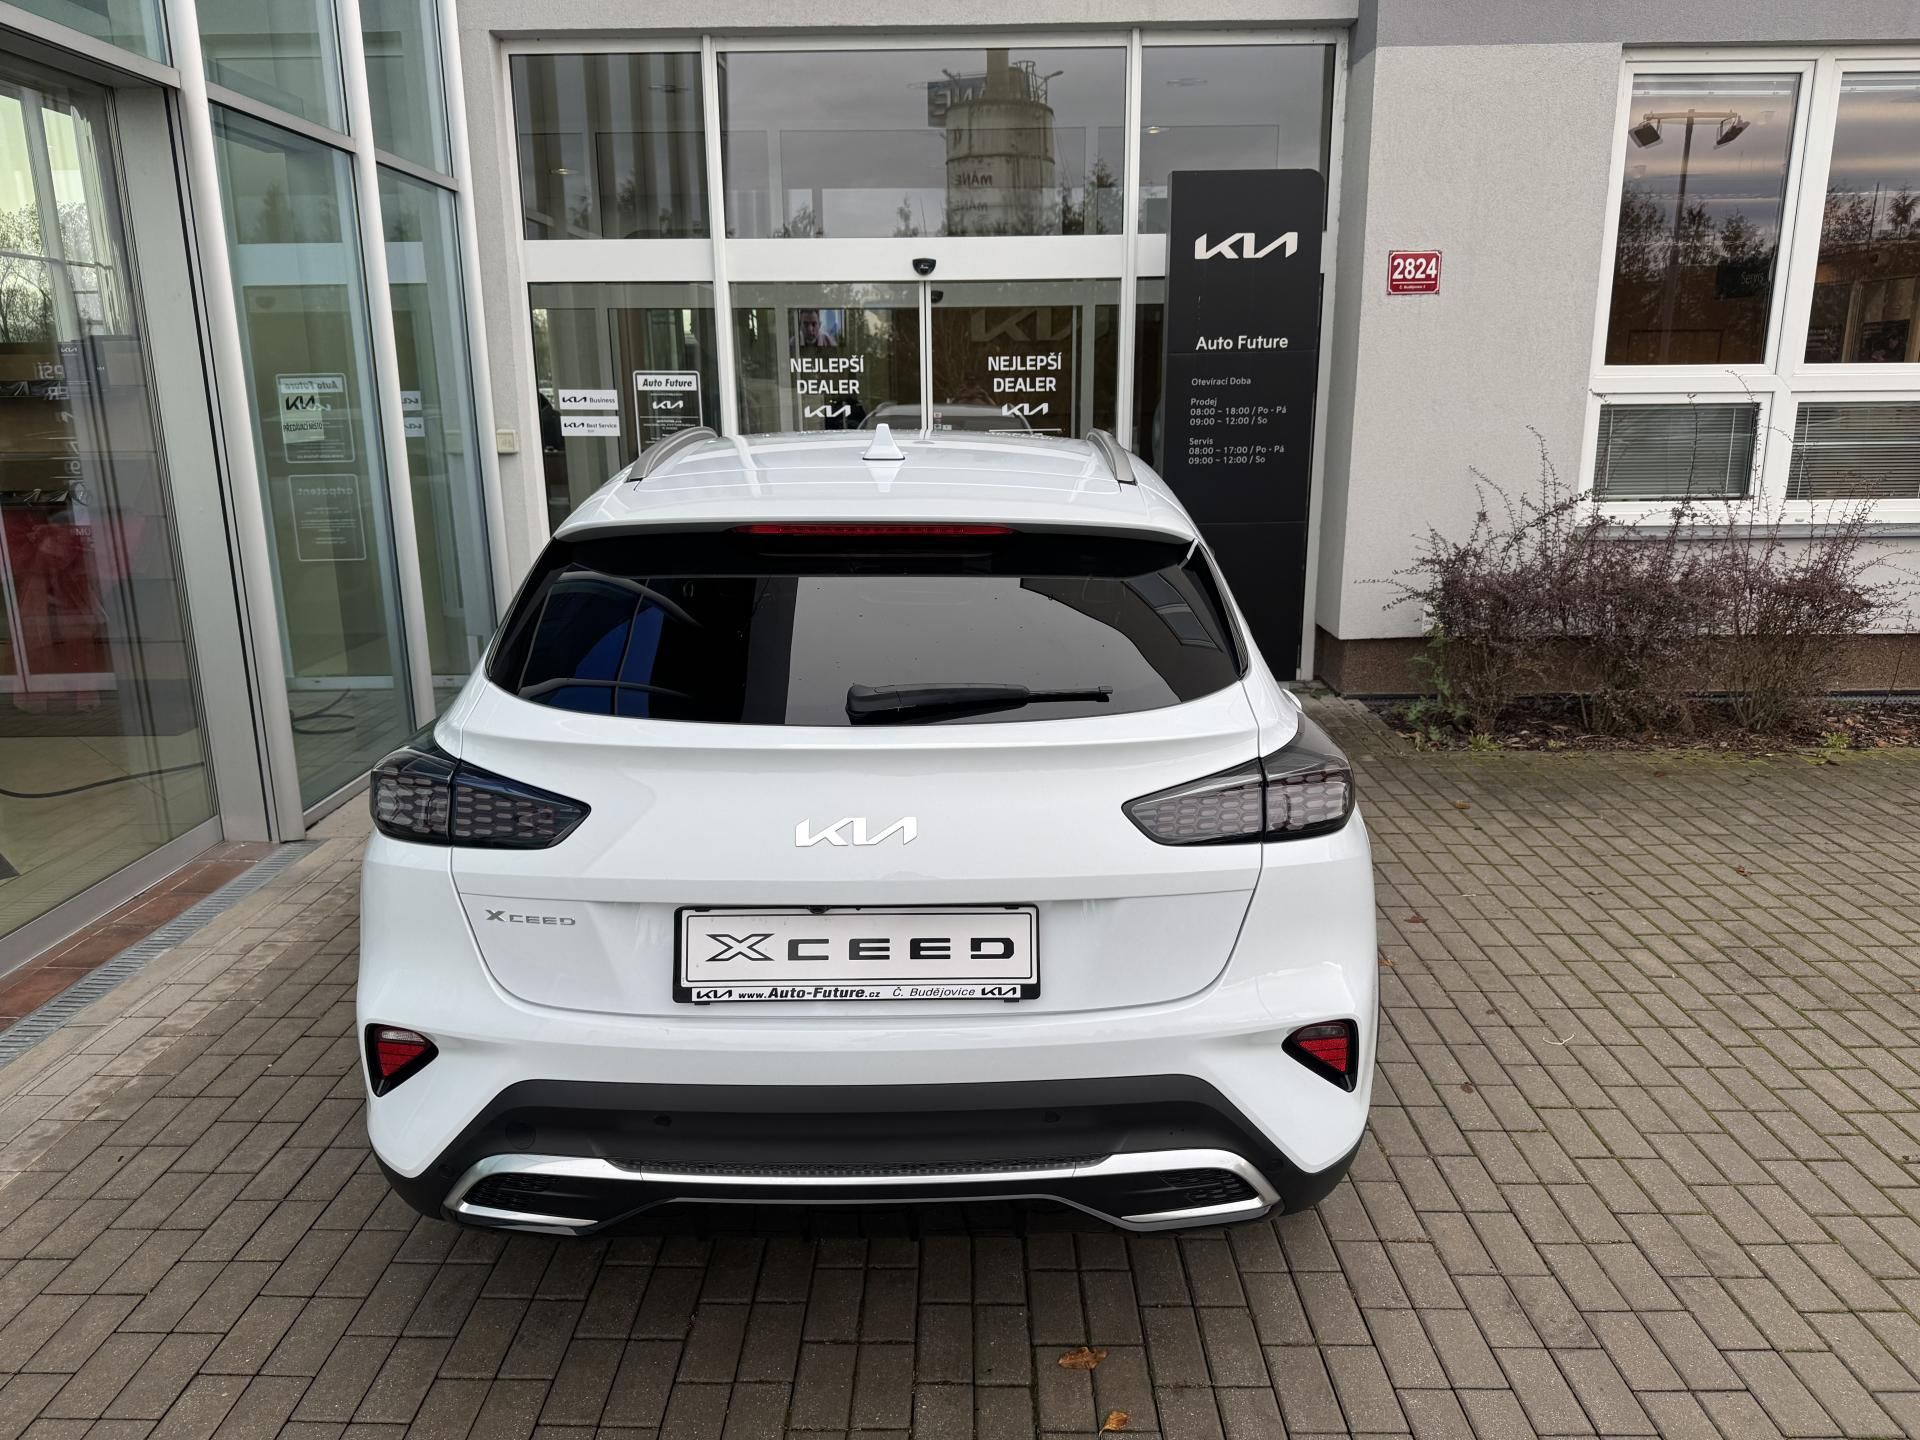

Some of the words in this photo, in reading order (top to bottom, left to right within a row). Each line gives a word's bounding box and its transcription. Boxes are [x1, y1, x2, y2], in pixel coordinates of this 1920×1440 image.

[1194, 231, 1298, 260] KIA
[1392, 257, 1437, 280] 2824
[1195, 336, 1234, 351] Auto
[1237, 335, 1289, 349] Future
[790, 354, 865, 373] NEJLEPŠÍ
[987, 352, 1063, 372] NEJLEPŠÍ
[642, 378, 663, 387] Auto
[664, 378, 693, 387] Future
[796, 379, 860, 395] DEALER
[993, 377, 1057, 393] DEALER
[1191, 377, 1228, 386] Otevírací
[1229, 377, 1252, 385] Doba
[652, 400, 684, 409] KIA
[1001, 402, 1049, 416] KIA
[1190, 397, 1218, 407] Prodej
[803, 404, 852, 418] KIA
[1225, 407, 1250, 415] 18:00
[1276, 405, 1287, 414] Pá
[1189, 417, 1215, 426] 09:00
[1225, 417, 1250, 425] 12:00
[1189, 437, 1214, 445] Servis
[1188, 447, 1214, 455] 08:00
[1223, 446, 1248, 454] 17:00
[1274, 444, 1285, 453] Pá
[1188, 457, 1214, 465] 09:00
[1223, 456, 1248, 464] 12:00
[794, 816, 918, 848] KIA
[485, 909, 576, 925] XCEED
[705, 933, 1015, 962] XCEED
[696, 989, 733, 999] KIA
[738, 987, 880, 999] www.Auto-Future.cz
[892, 986, 904, 997] Č.
[909, 986, 976, 997] Budějovice
[981, 987, 1017, 996] KIA
